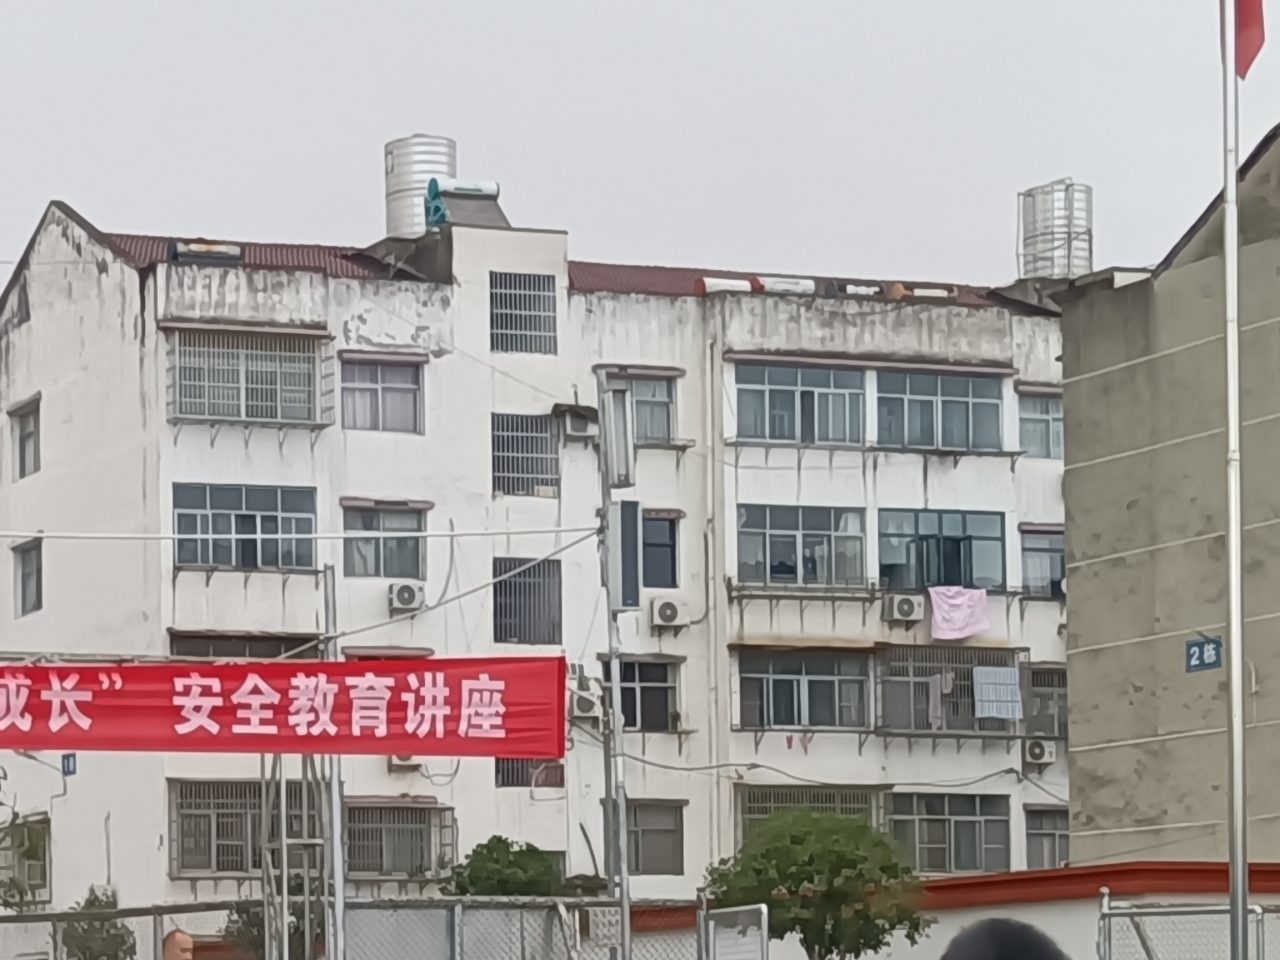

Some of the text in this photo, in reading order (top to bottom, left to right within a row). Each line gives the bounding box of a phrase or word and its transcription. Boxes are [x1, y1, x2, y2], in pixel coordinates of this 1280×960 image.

[171, 671, 508, 739] 安全教育讲座
